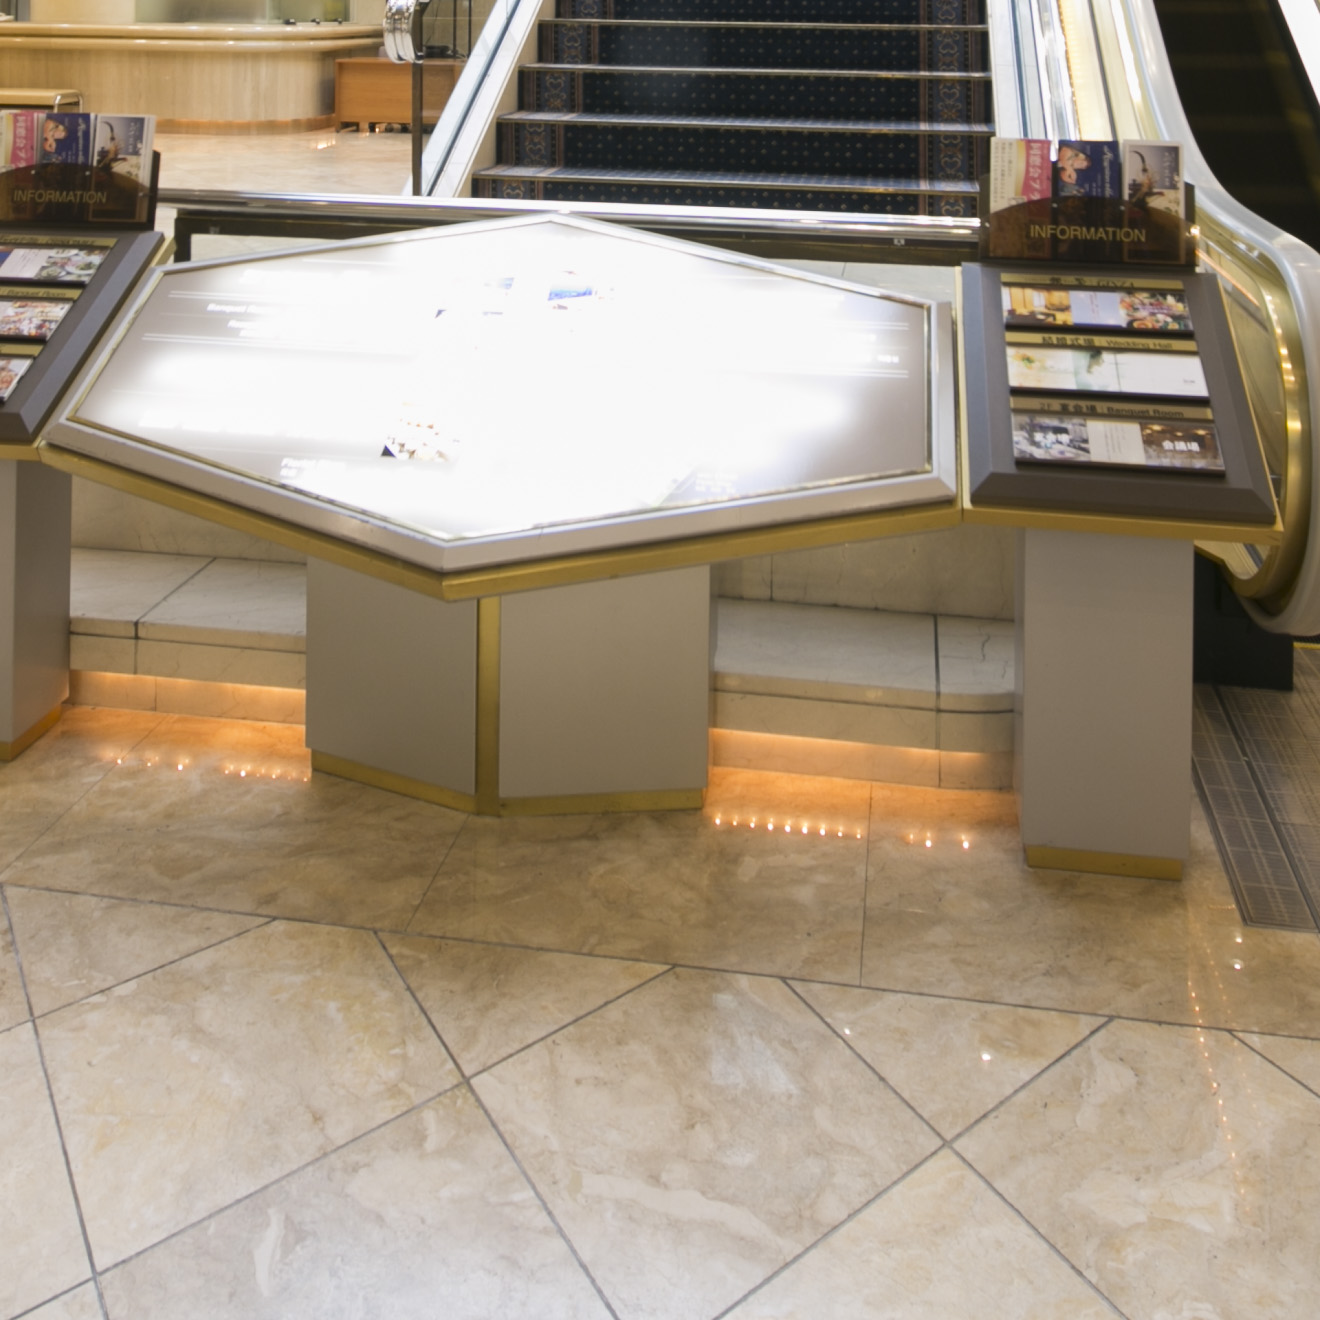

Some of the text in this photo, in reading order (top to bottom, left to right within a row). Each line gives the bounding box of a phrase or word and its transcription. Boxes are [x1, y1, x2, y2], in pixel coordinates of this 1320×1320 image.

[13, 189, 108, 204] INFORMATION
[1030, 224, 1146, 242] INFORMATION
[1105, 339, 1151, 350] Wedding
[1152, 341, 1173, 350] Hall
[1106, 406, 1152, 418] Banquet
[1153, 408, 1184, 419] Room
